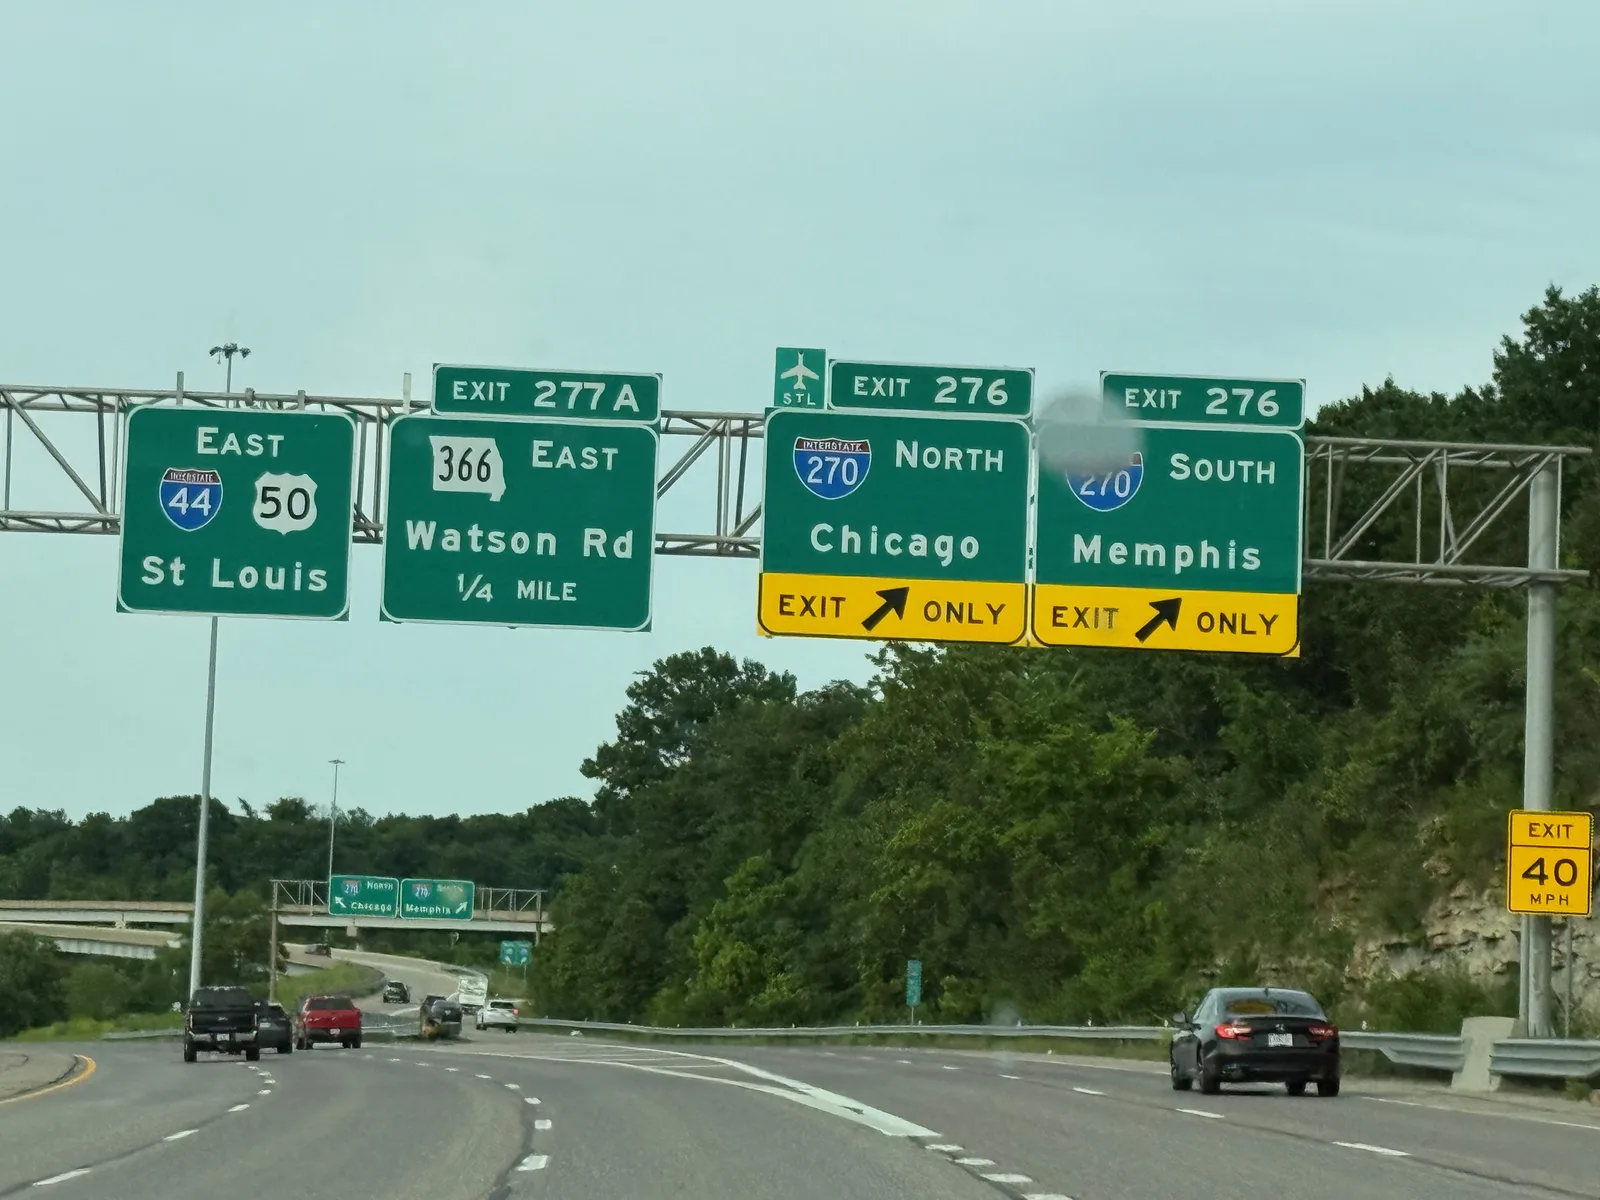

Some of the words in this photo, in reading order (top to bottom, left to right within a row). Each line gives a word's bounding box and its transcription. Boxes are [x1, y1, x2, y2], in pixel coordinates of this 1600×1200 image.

[453, 381, 511, 402] EXIT
[782, 392, 817, 406] STL
[855, 376, 911, 398] EXIT
[935, 376, 1009, 406] 276
[1125, 388, 1182, 410] EXIT
[1206, 388, 1280, 417] 276
[197, 426, 285, 458] EAST
[531, 439, 619, 471] EAST
[803, 441, 863, 452] INTERSTATE
[895, 439, 1005, 473] NORTH
[438, 445, 492, 483] 366
[807, 455, 859, 486] 270
[1169, 452, 1276, 485] SOUTH
[168, 487, 212, 517] 44
[259, 486, 311, 520] 50
[406, 519, 556, 556] Watson
[583, 527, 633, 560] Rd
[811, 522, 980, 567] Chicago
[1073, 533, 1261, 574] Memphis
[141, 555, 186, 586] St
[211, 557, 328, 592] Louis
[457, 573, 494, 603] 1/4
[517, 579, 577, 602] MILE
[779, 593, 847, 619] EXIT
[924, 600, 1006, 624] ONLY
[1052, 605, 1119, 630] EXIT
[1197, 611, 1279, 636] ONLY
[1529, 823, 1574, 839] EXIT
[1521, 857, 1578, 887] 40
[351, 901, 392, 913] Chicago
[406, 903, 451, 915] Memphis
[1530, 893, 1569, 906] MPH
